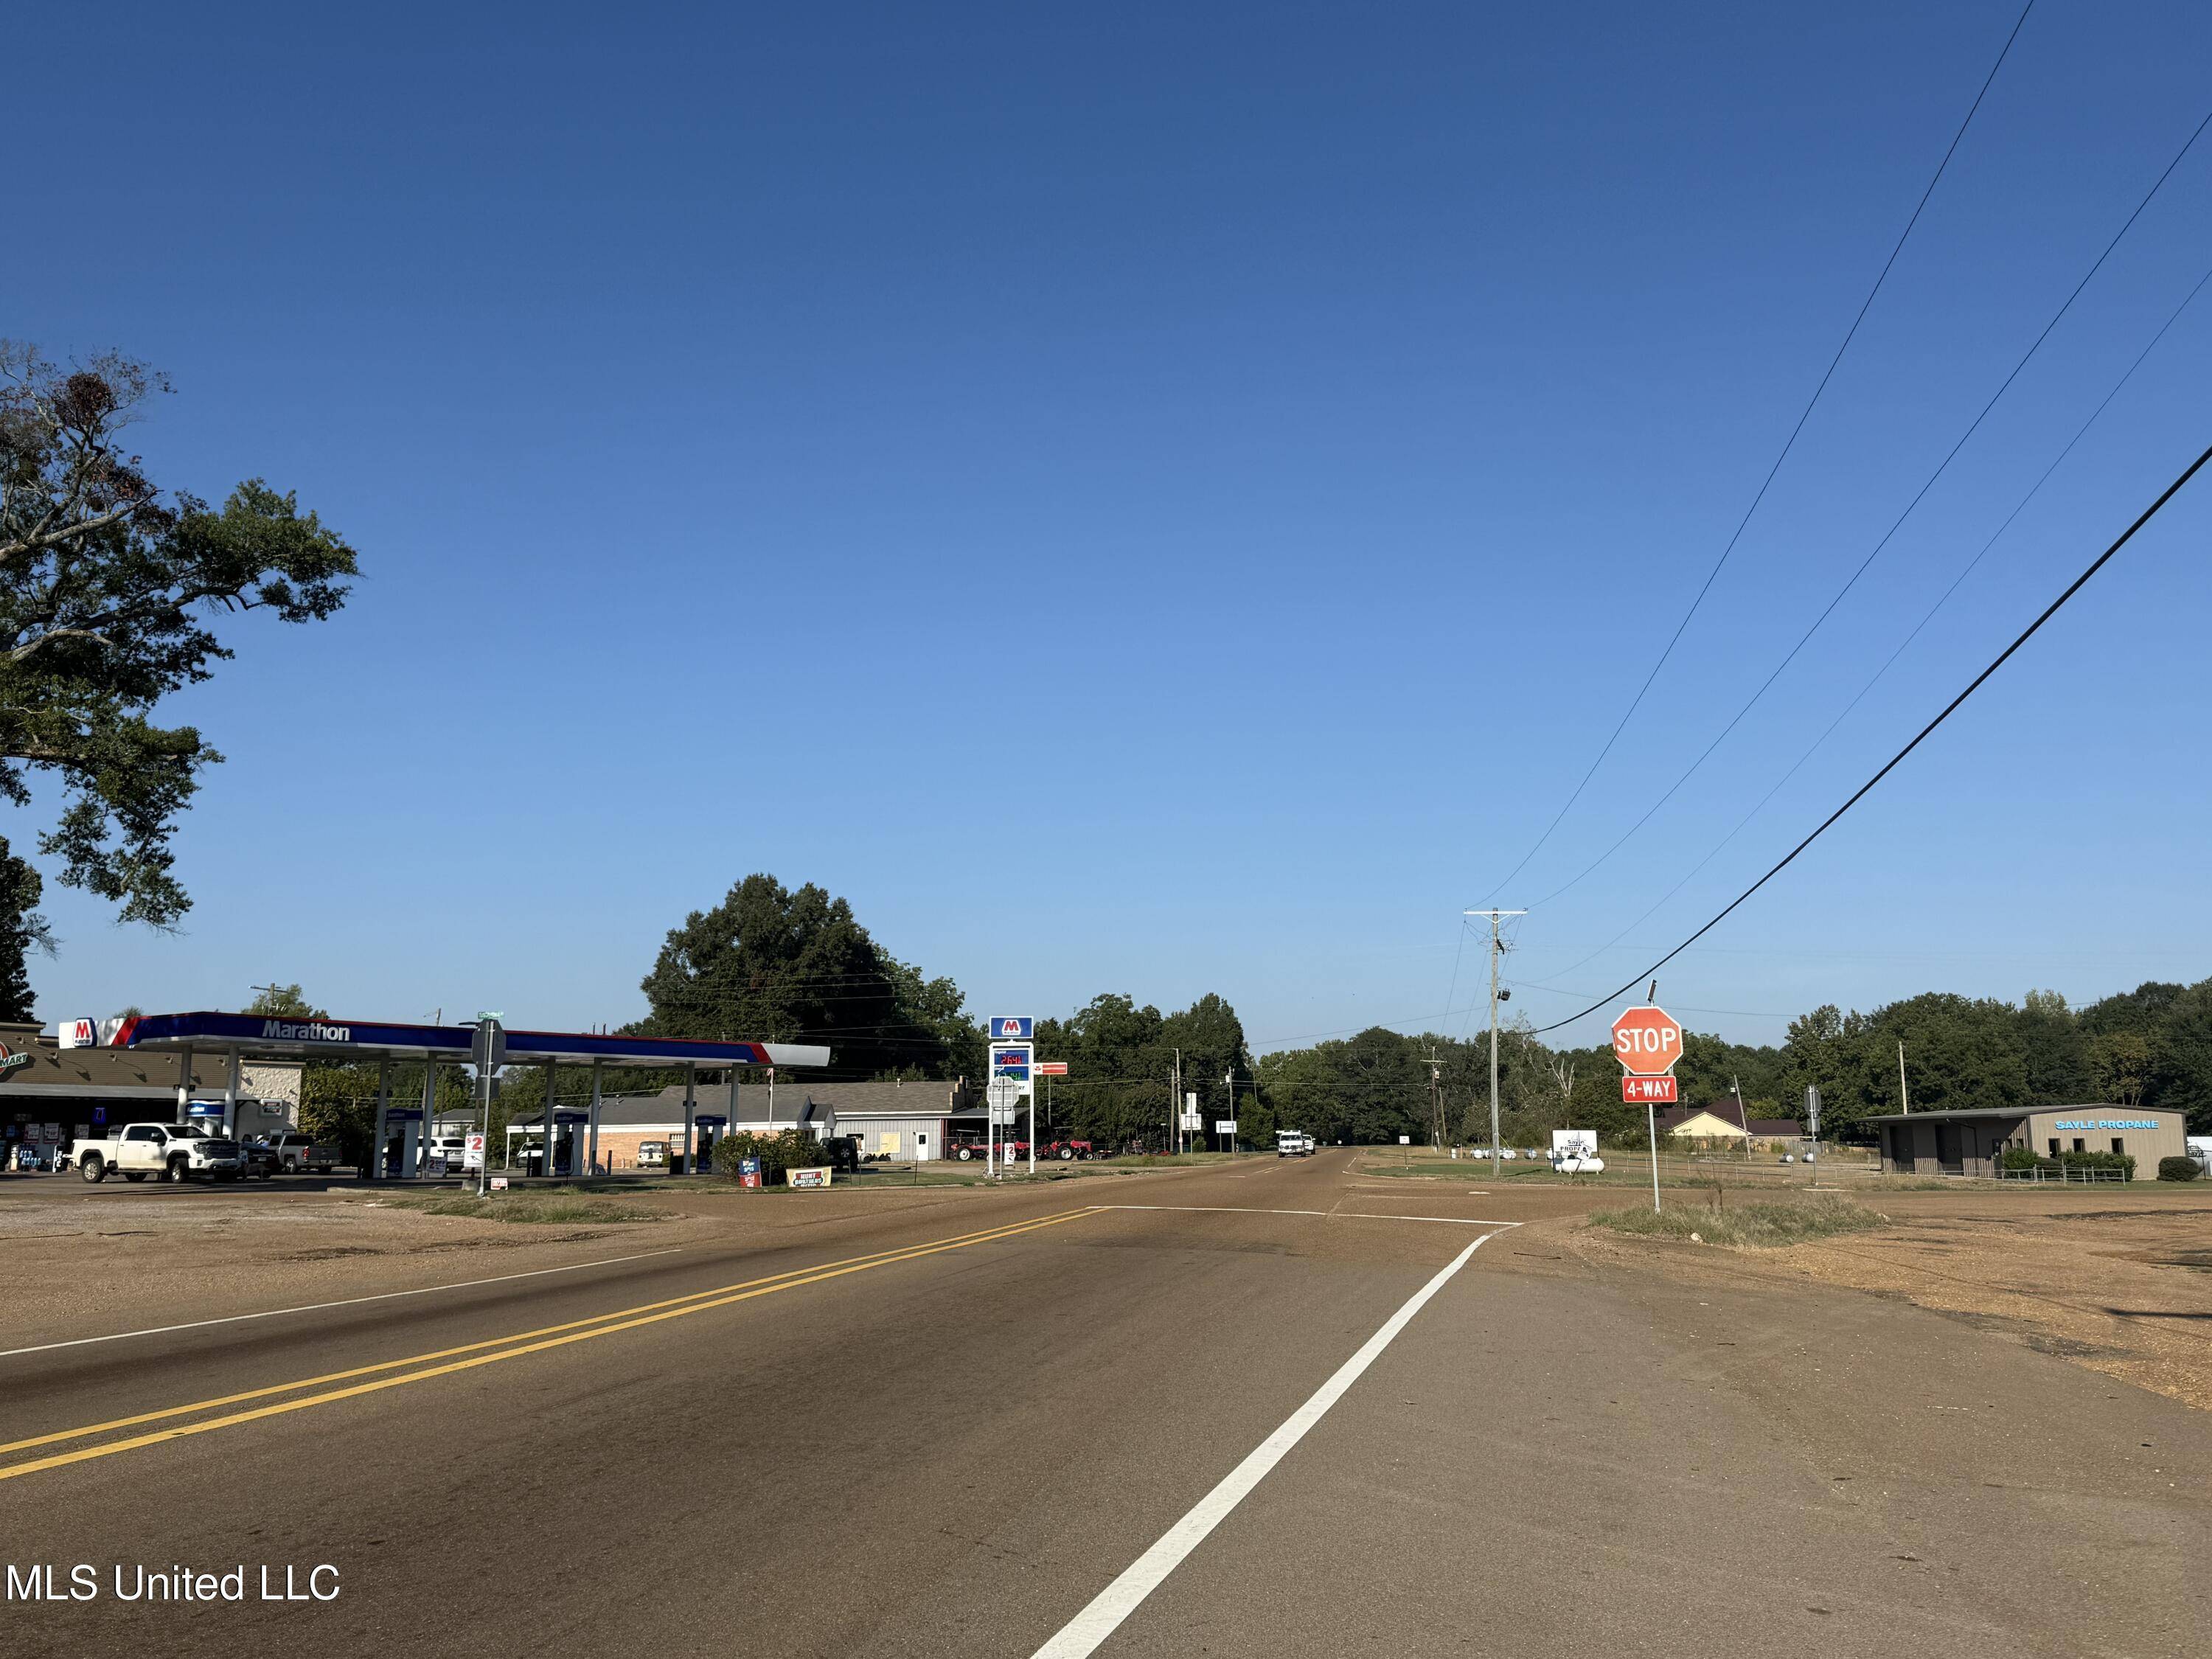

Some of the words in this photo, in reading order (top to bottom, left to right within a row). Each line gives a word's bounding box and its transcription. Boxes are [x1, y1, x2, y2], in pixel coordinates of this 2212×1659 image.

[262, 1020, 350, 1041] Marathon
[1616, 1027, 1677, 1053] STOP
[1627, 1081, 1671, 1097] 4-WAY
[2055, 1120, 2095, 1130] SAYLE
[2098, 1120, 2159, 1130] PROPANE
